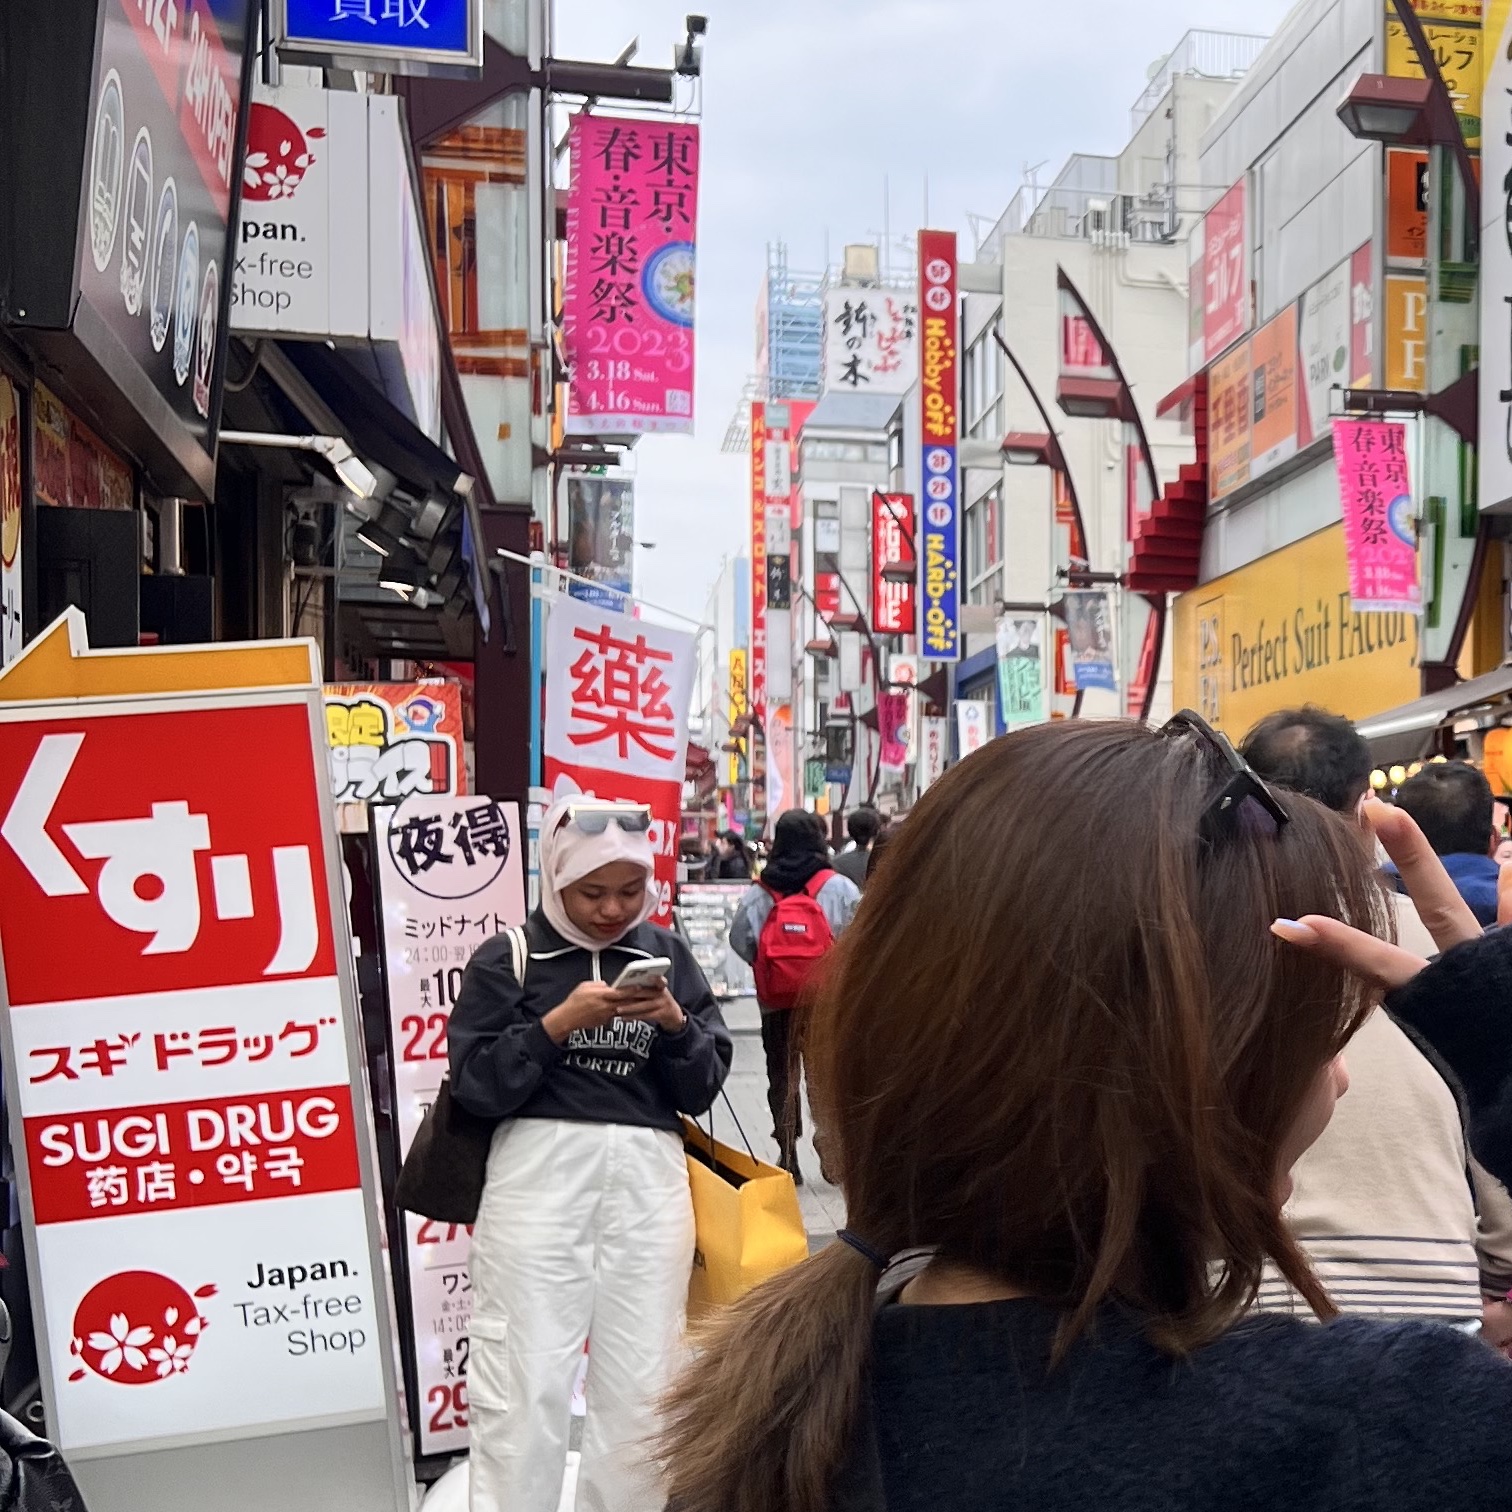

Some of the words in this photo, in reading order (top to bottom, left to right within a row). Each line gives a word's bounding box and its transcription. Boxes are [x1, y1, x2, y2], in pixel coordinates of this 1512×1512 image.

[586, 325, 692, 373] 2023
[1231, 617, 1288, 693] Perfect
[1294, 598, 1332, 675] Suit
[0, 732, 320, 976] くすり
[397, 800, 511, 876] 夜得
[404, 912, 507, 940] ミッドナイト
[40, 1112, 170, 1167] SUGI
[186, 1096, 341, 1152] DRUG
[246, 1257, 360, 1291] Japan.
[233, 1293, 364, 1328] Tax-free
[287, 1327, 367, 1357] Shop
